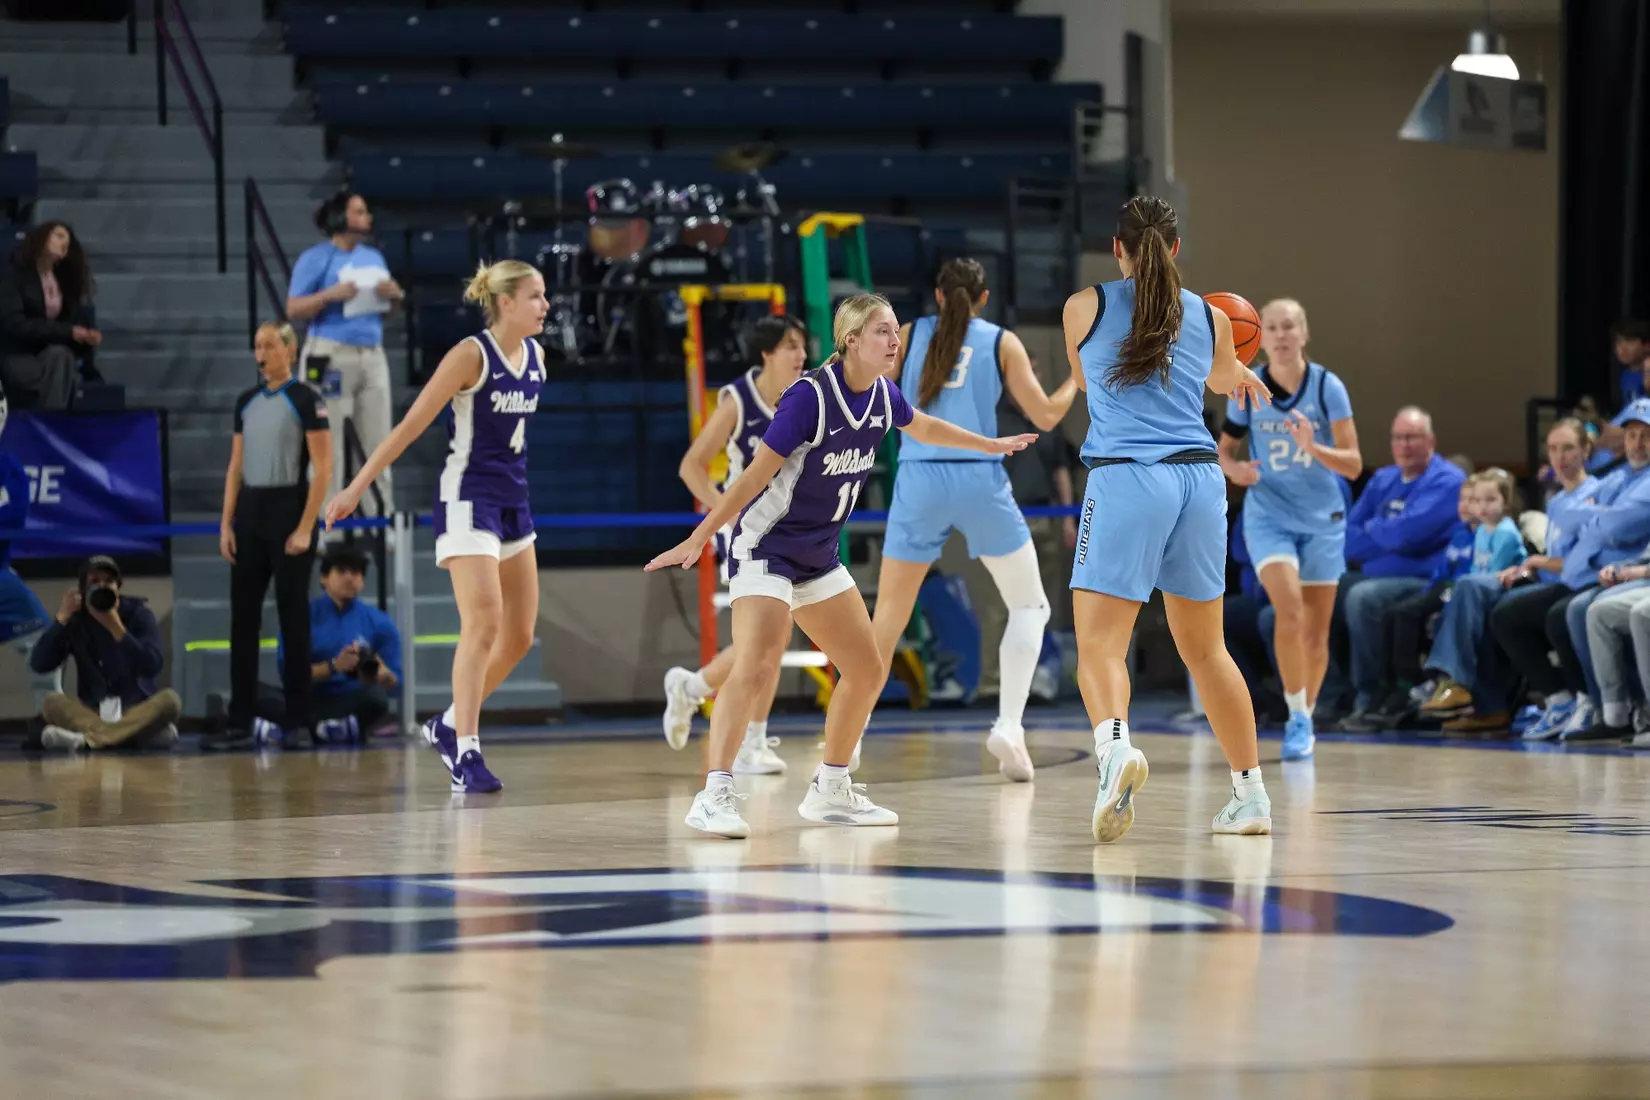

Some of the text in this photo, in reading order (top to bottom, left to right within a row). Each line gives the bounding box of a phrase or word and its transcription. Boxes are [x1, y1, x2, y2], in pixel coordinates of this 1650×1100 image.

[490, 390, 539, 414] Wildcat
[509, 417, 526, 454] 4
[821, 445, 876, 476] Wildcats
[1268, 439, 1313, 471] 24
[830, 480, 861, 523] 11
[1078, 498, 1096, 566] BLUEJAYS
